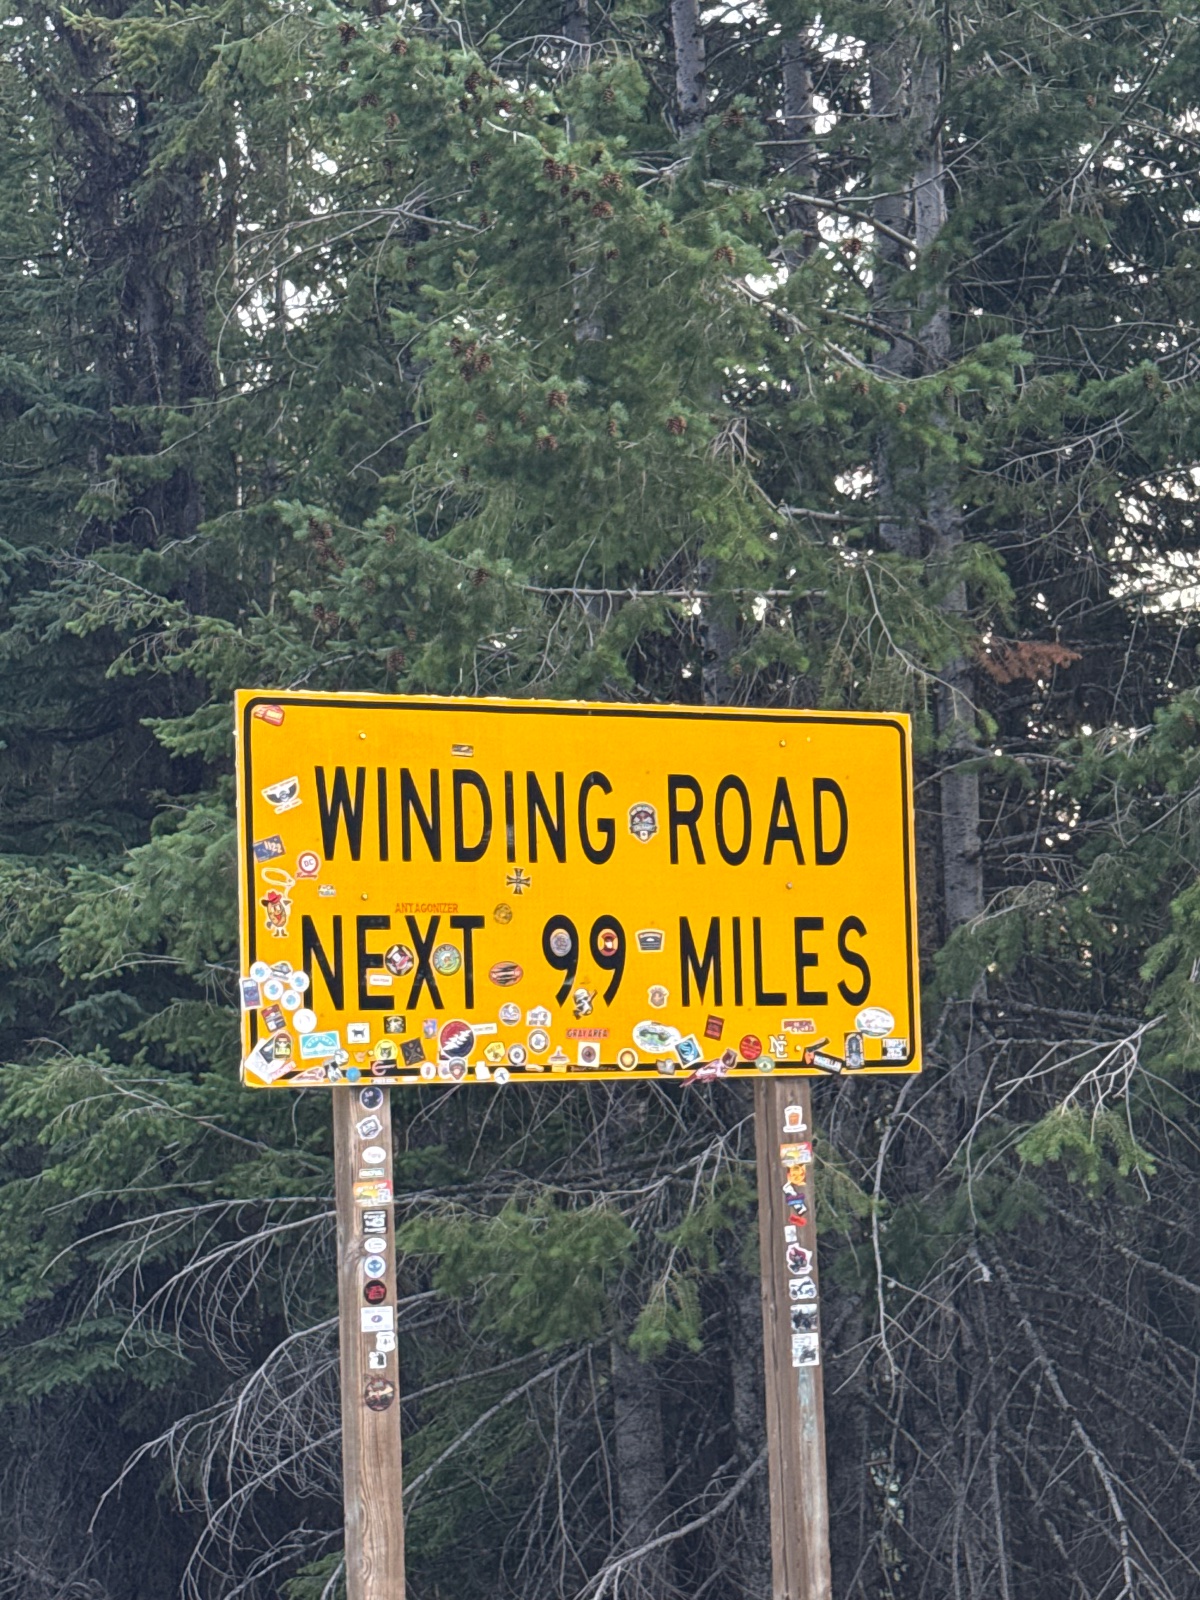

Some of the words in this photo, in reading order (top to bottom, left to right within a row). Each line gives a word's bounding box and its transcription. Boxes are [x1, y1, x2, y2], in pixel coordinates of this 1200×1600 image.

[314, 765, 616, 865] WINDING
[667, 774, 849, 867] ROAD
[394, 902, 459, 914] ANTAGONIZER
[301, 914, 485, 1011] NEXT
[542, 914, 627, 1008] 99
[679, 915, 872, 1008] MILES
[566, 1029, 587, 1038] GRAY
[588, 1029, 609, 1038] AREA
